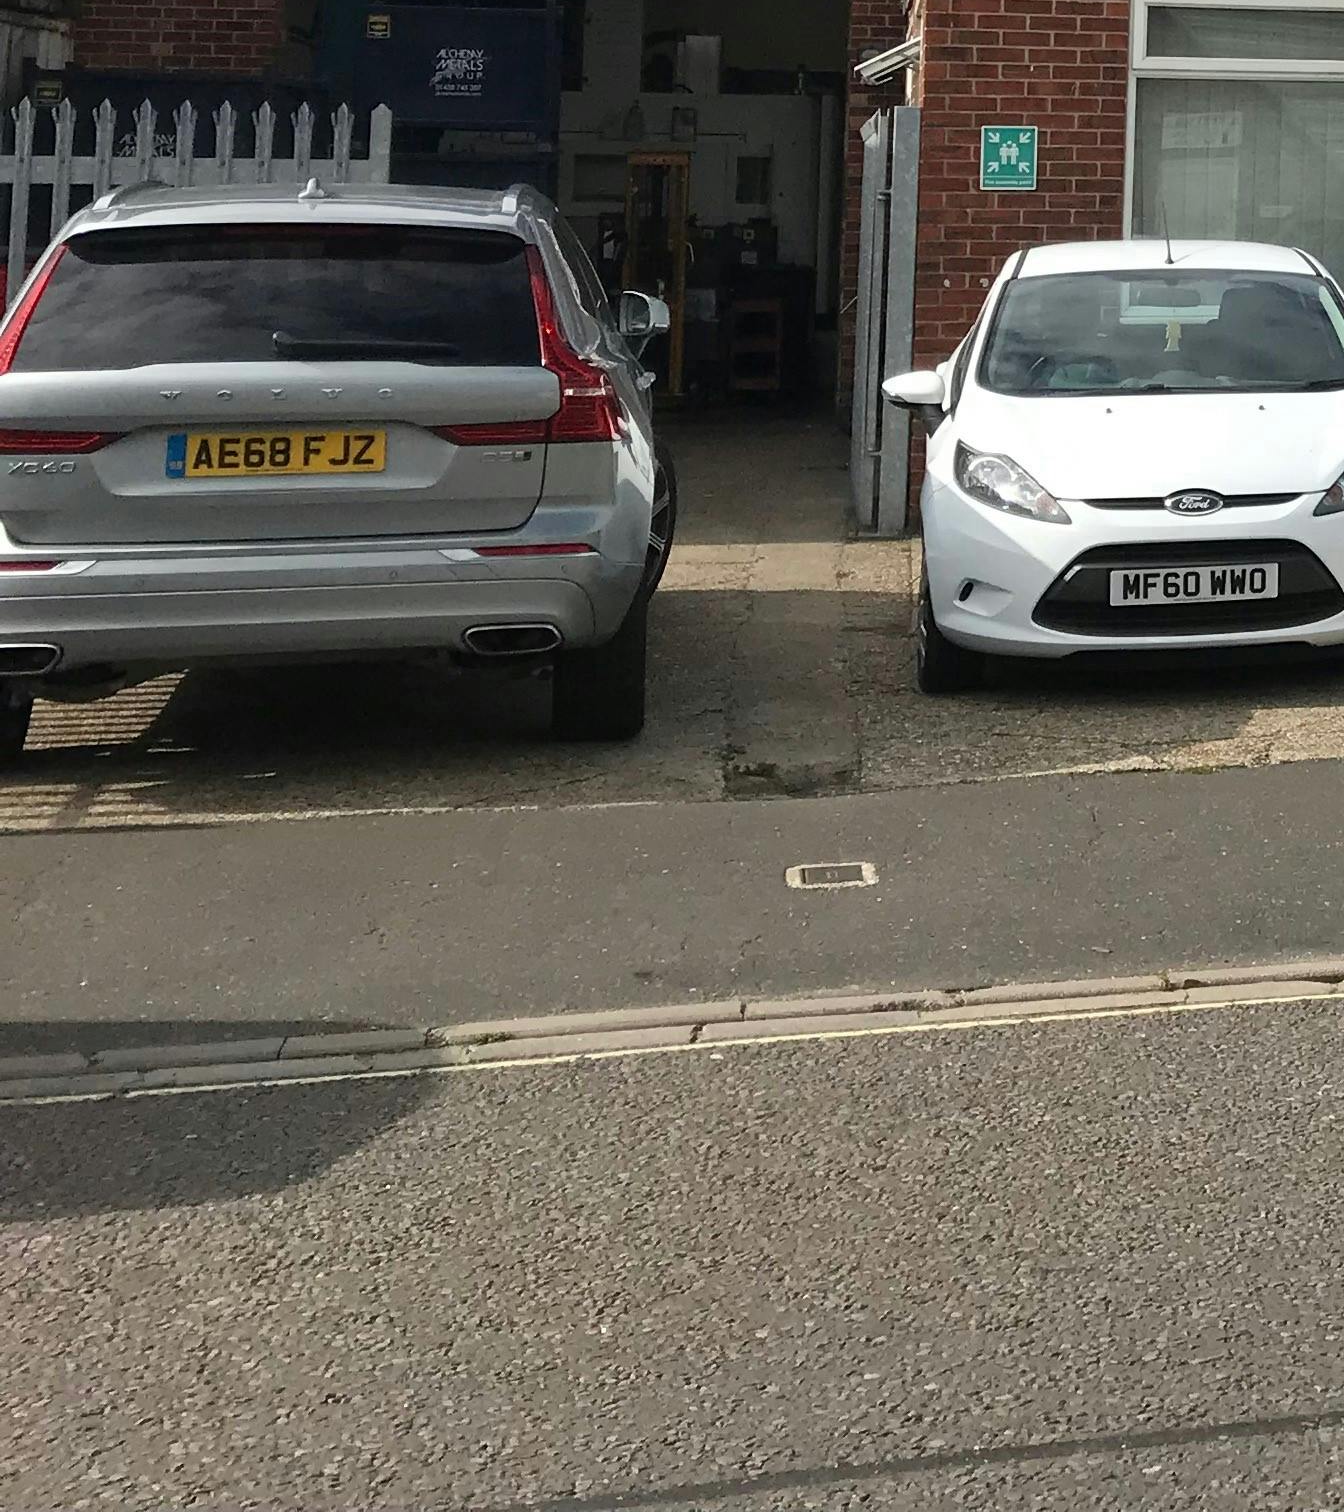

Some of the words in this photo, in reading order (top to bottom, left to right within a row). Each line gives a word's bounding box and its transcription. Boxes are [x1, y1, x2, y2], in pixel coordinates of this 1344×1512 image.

[435, 59, 484, 70] METALS
[192, 436, 291, 470] AE68
[302, 434, 376, 467] FJZ
[1178, 495, 1210, 510] Ford
[1122, 571, 1201, 600] MF60
[1210, 568, 1267, 596] WWO
